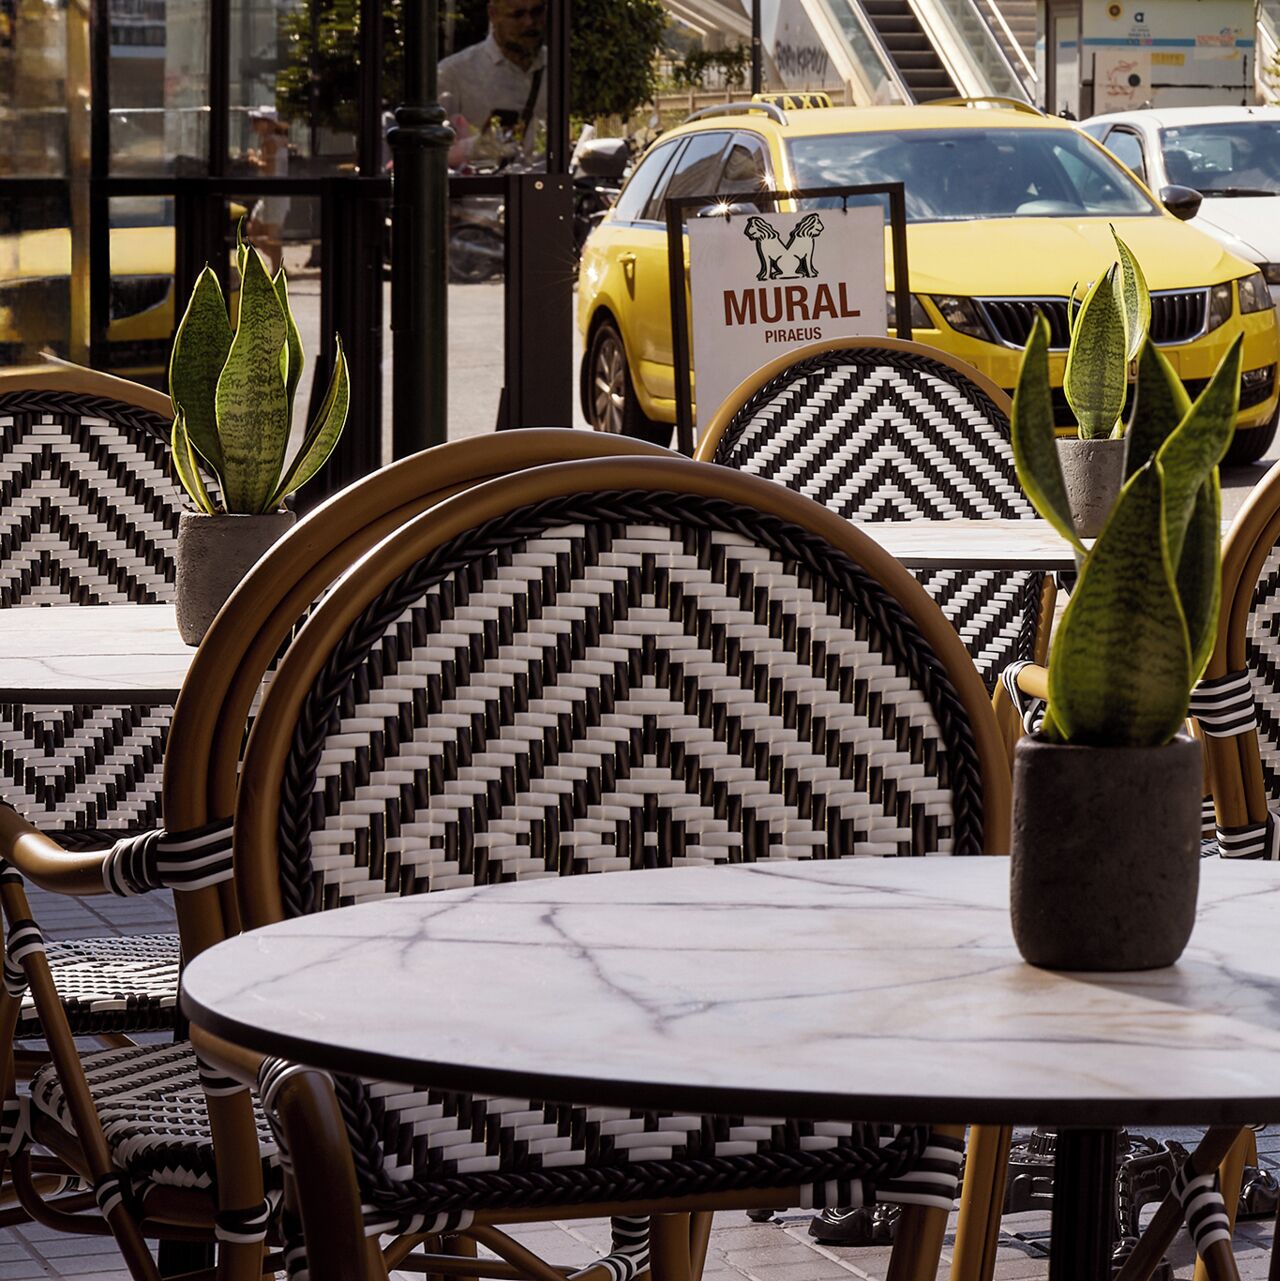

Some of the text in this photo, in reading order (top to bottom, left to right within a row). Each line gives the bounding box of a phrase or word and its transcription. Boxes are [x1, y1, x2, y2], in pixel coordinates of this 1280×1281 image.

[764, 95, 825, 111] TAXI
[723, 281, 861, 327] MURAL
[765, 327, 822, 344] PIRAEUS
